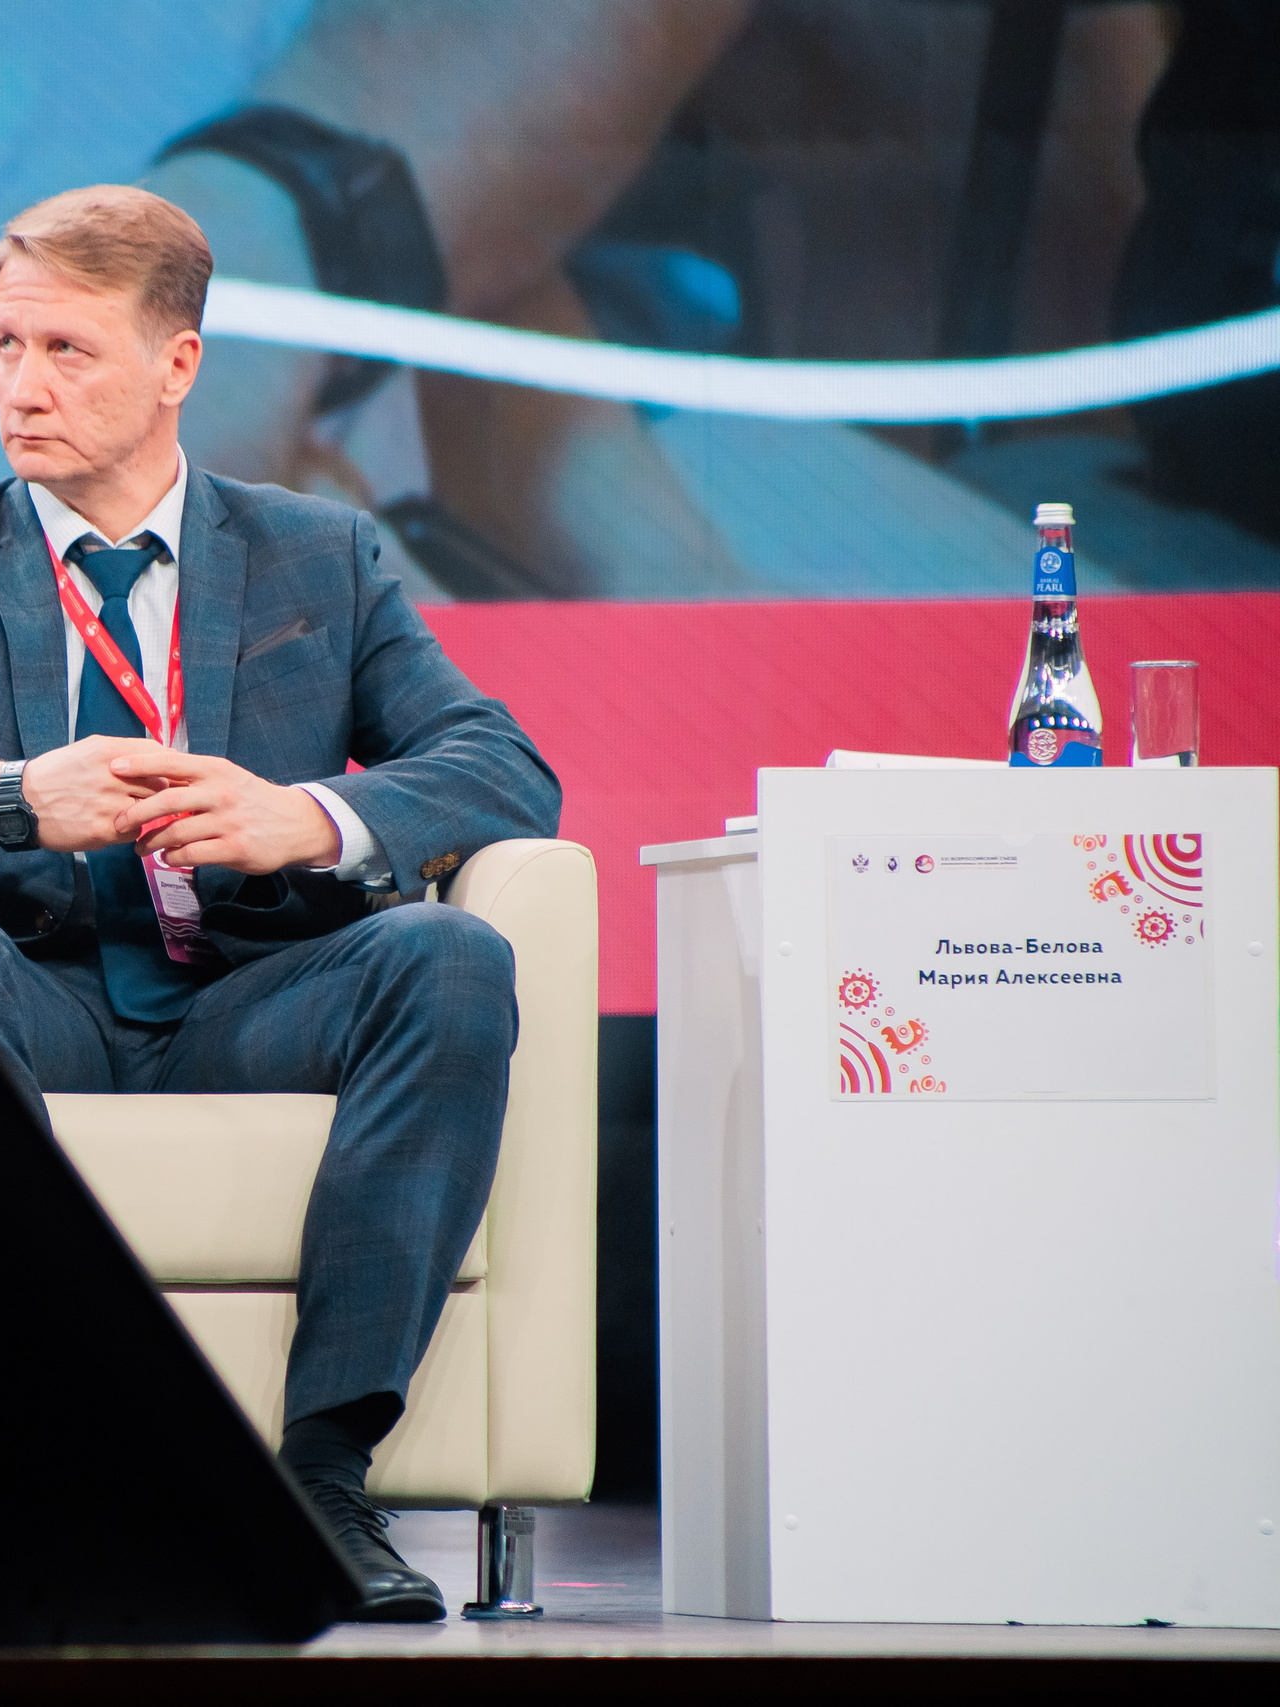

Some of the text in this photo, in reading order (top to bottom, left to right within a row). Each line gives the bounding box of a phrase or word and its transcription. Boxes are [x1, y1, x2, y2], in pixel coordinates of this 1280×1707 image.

[1036, 583, 1063, 592] PEARL
[935, 938, 1104, 955] Львова-Белова
[918, 969, 1123, 990] Мария Алексеевна
